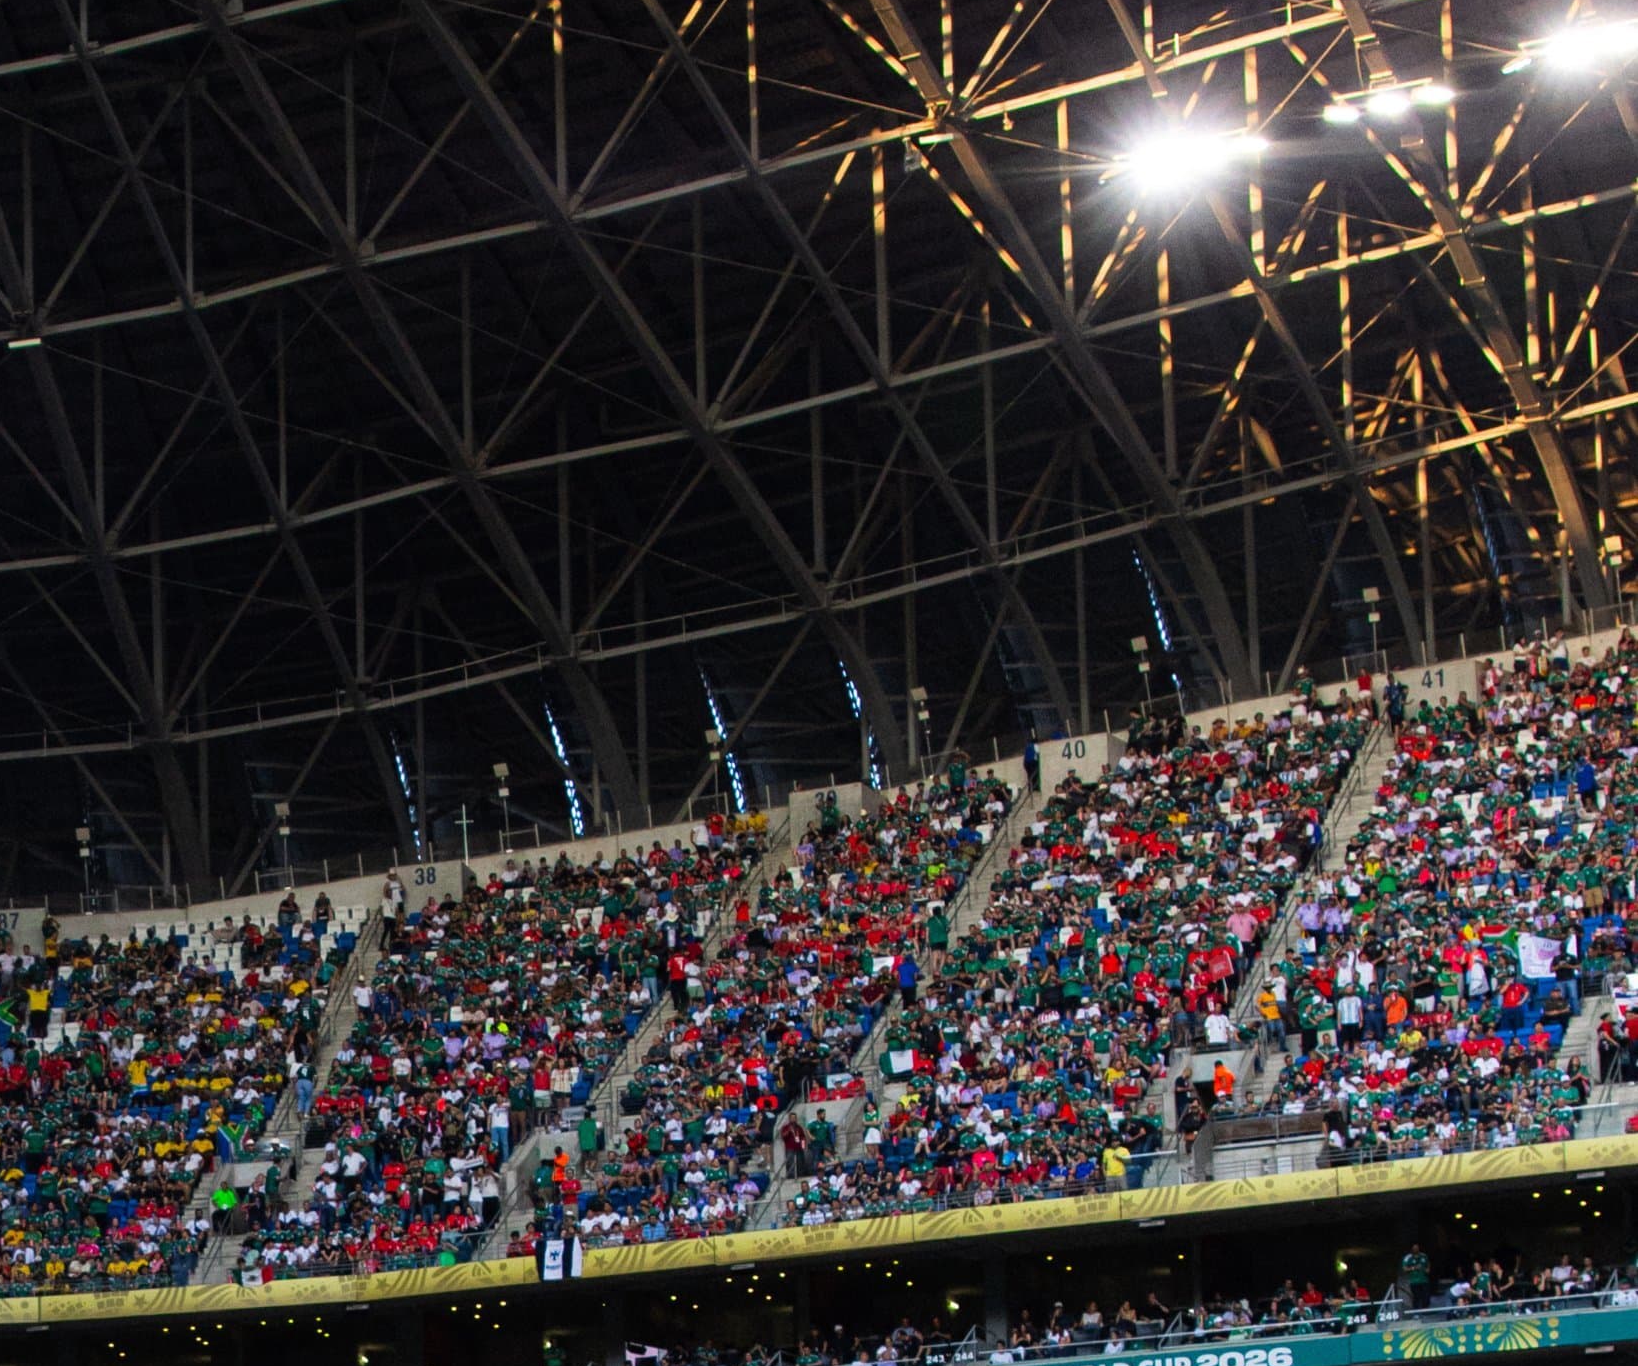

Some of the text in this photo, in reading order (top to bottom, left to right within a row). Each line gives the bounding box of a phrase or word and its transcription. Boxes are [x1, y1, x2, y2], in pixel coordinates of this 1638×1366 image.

[1421, 668, 1444, 688] 41
[1062, 739, 1085, 759] 40
[415, 866, 436, 885] 38
